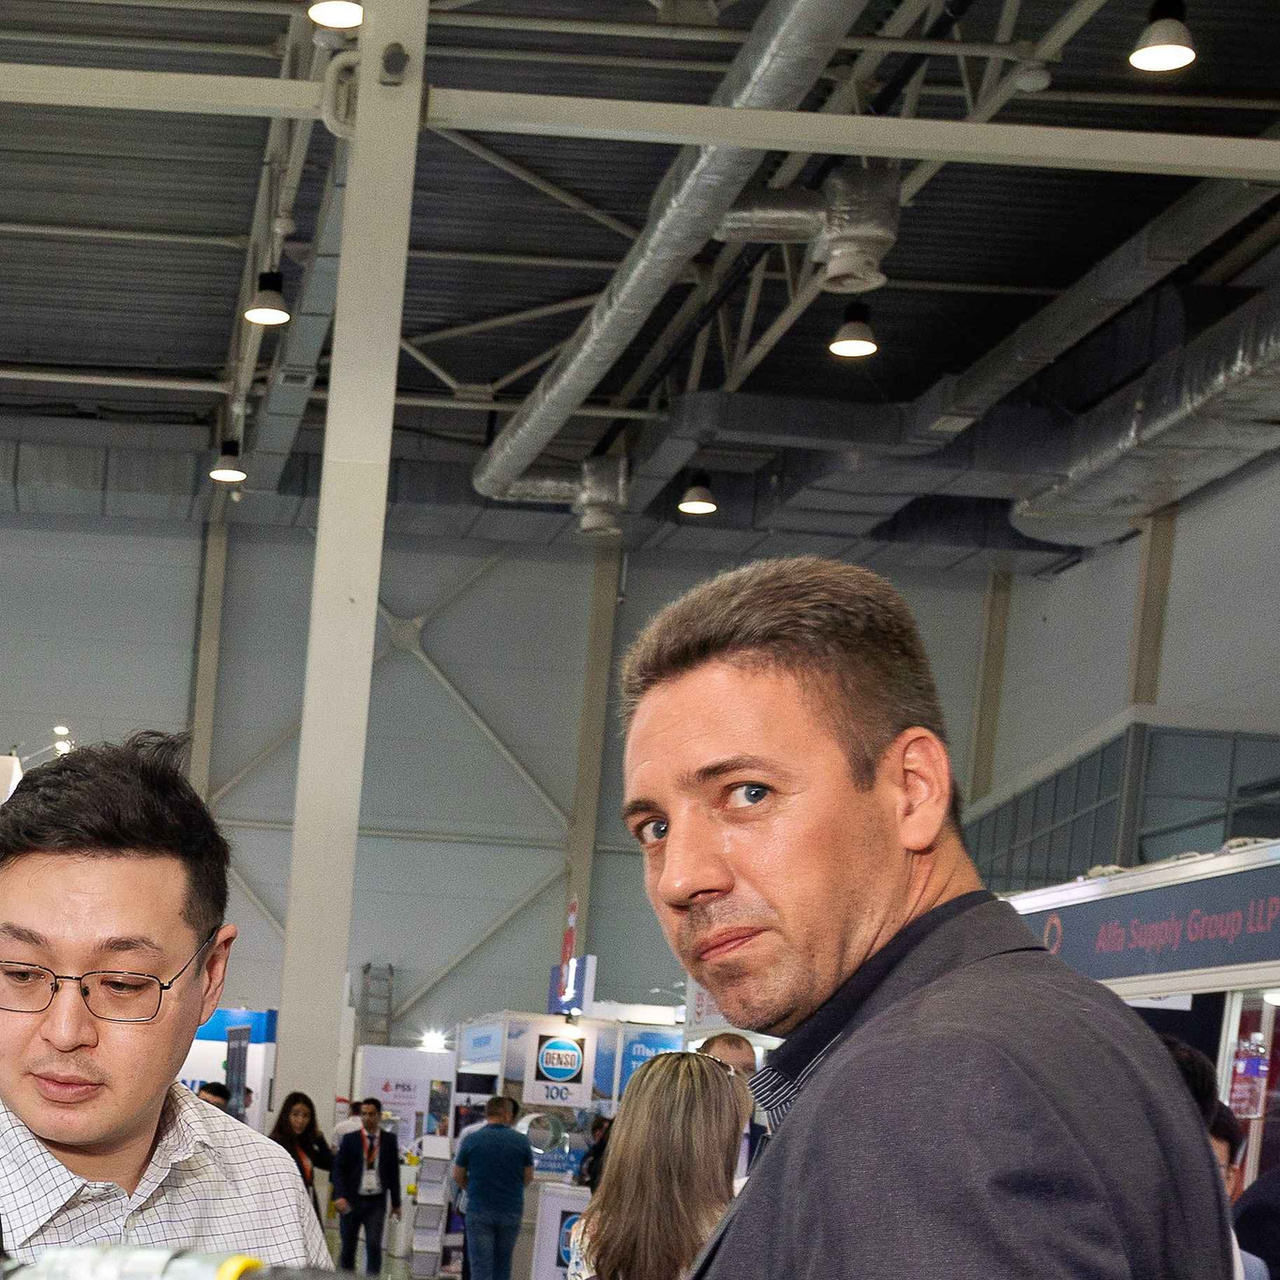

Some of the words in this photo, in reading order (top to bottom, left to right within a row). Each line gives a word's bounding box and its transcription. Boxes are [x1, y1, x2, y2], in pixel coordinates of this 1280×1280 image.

[1185, 908, 1243, 944] Group
[1246, 896, 1280, 933] LLP
[545, 1052, 576, 1067] DENSO
